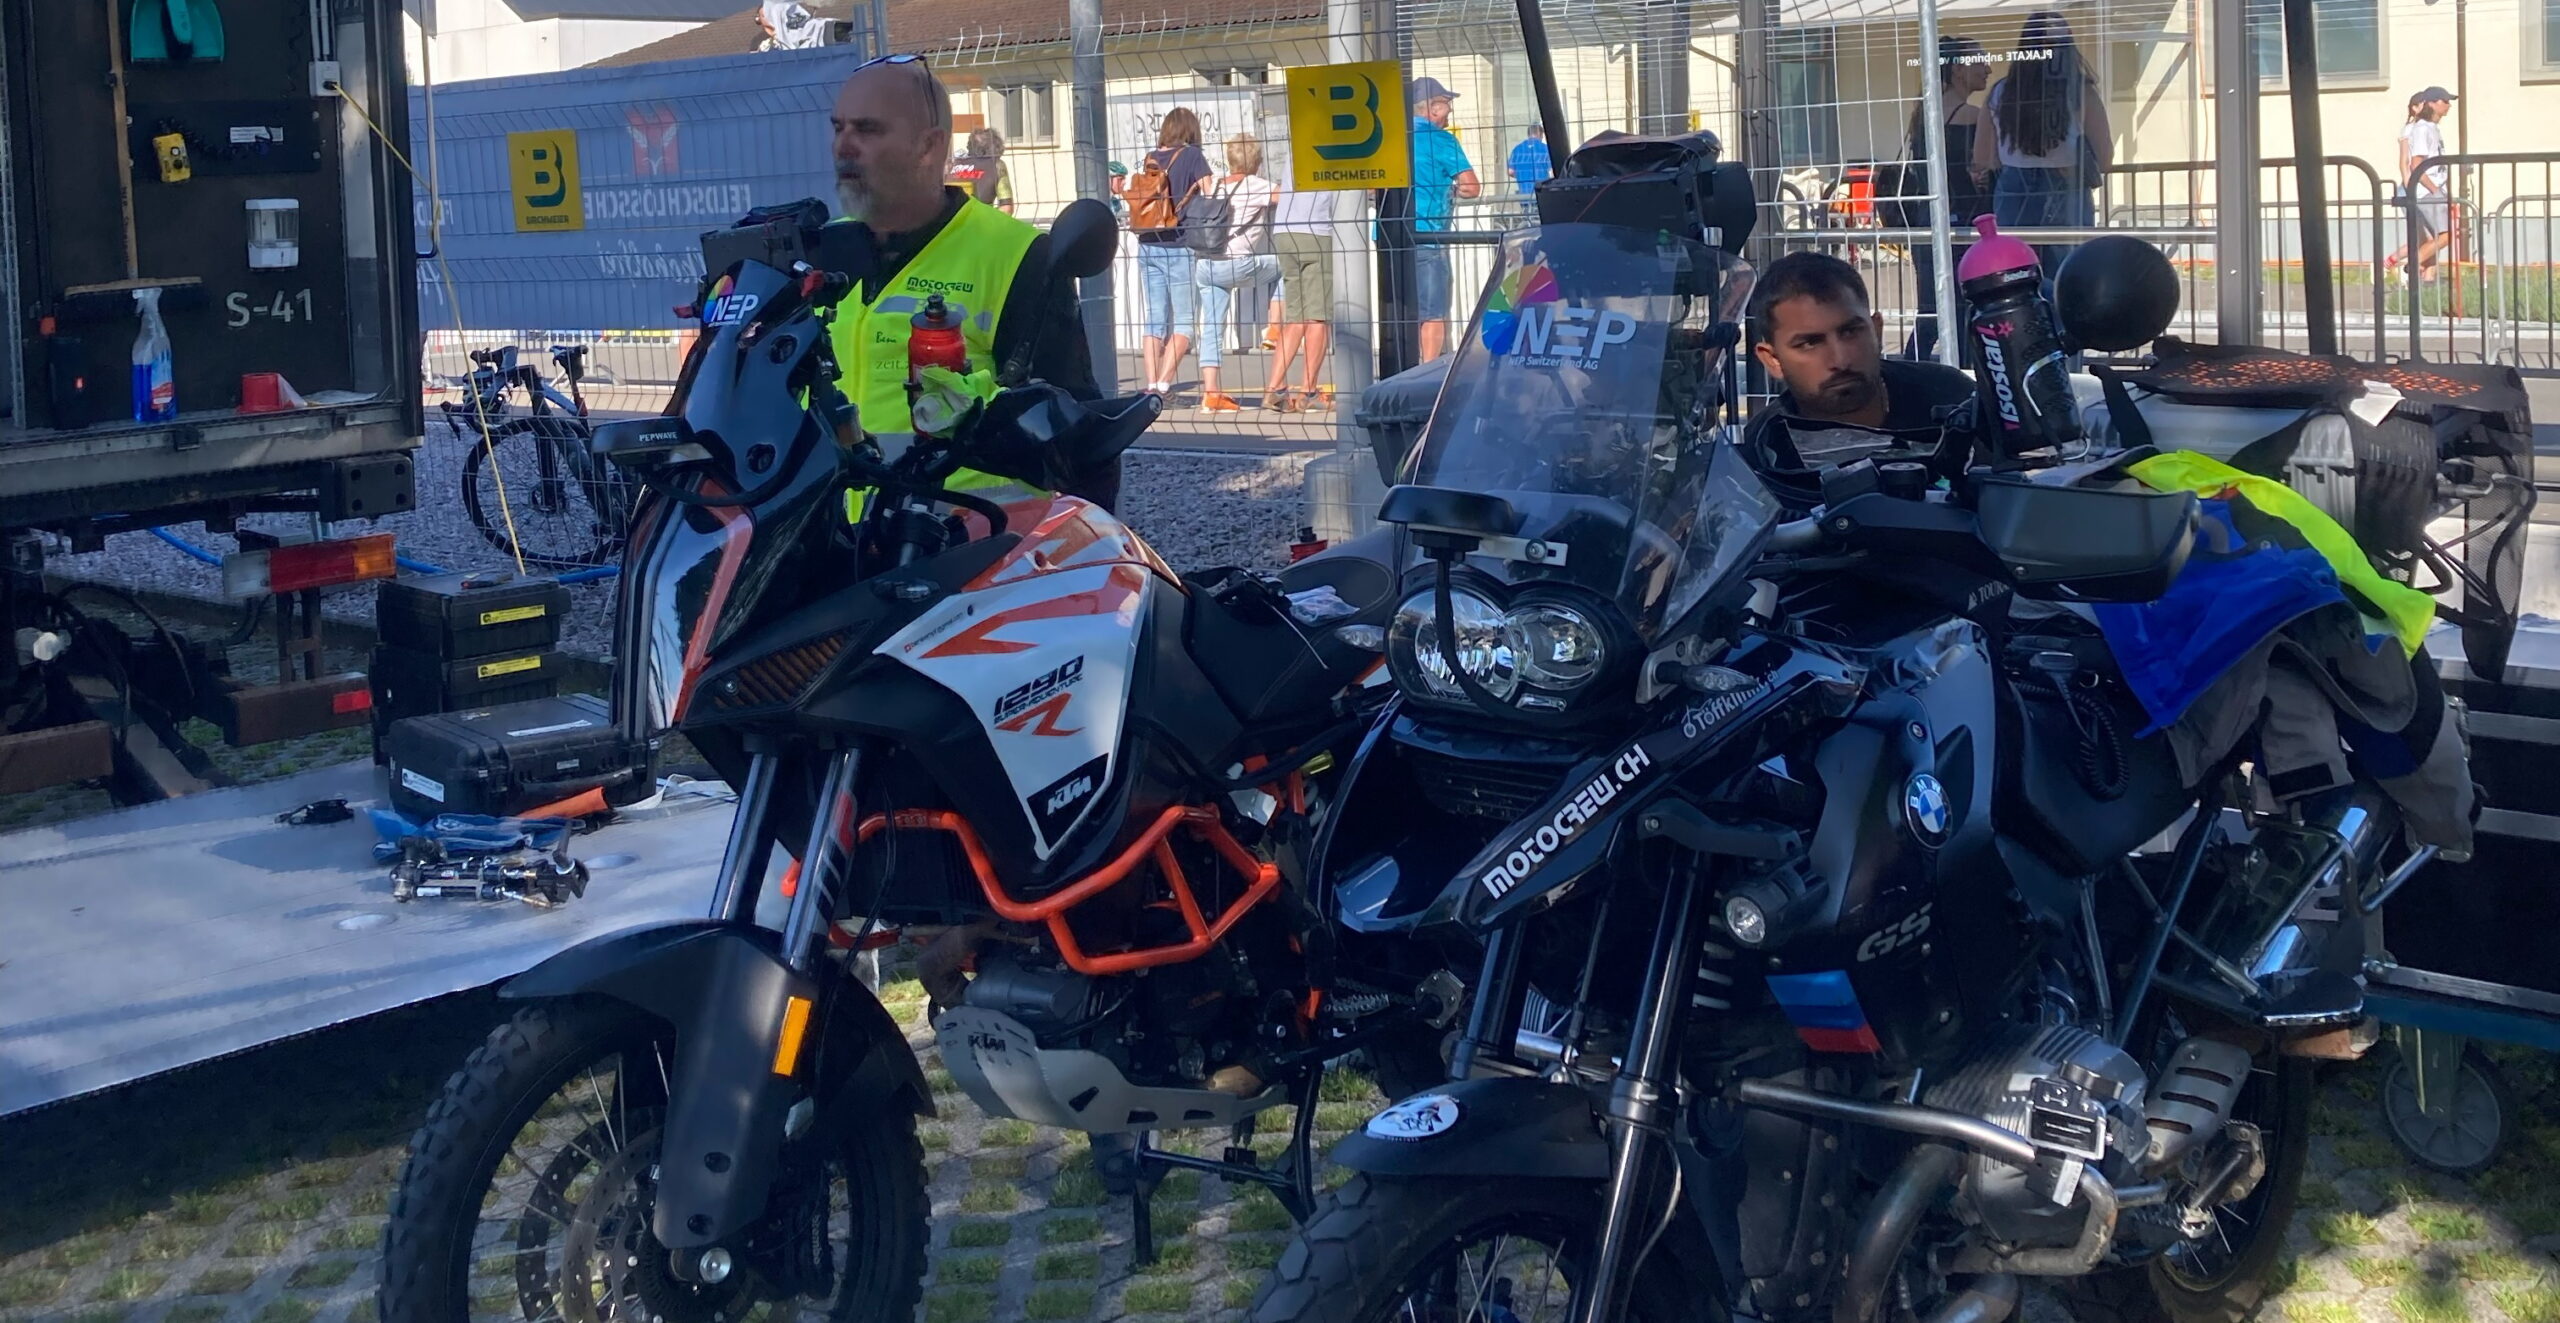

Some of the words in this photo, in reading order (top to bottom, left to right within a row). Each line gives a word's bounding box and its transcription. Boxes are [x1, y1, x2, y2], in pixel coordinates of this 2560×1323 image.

[1312, 168, 1387, 182] BIRCHMEIER
[226, 288, 314, 328] S-41
[711, 294, 760, 322] NEP
[1511, 307, 1637, 360] NEP
[1583, 360, 1599, 371] AG
[638, 431, 678, 443] PEPWAVE
[993, 655, 1085, 716] 1290
[1047, 775, 1092, 816] KTM
[1481, 743, 1652, 900] MOTOCREW.CH
[1856, 902, 1933, 962] GS
[967, 1032, 1007, 1052] KTM
